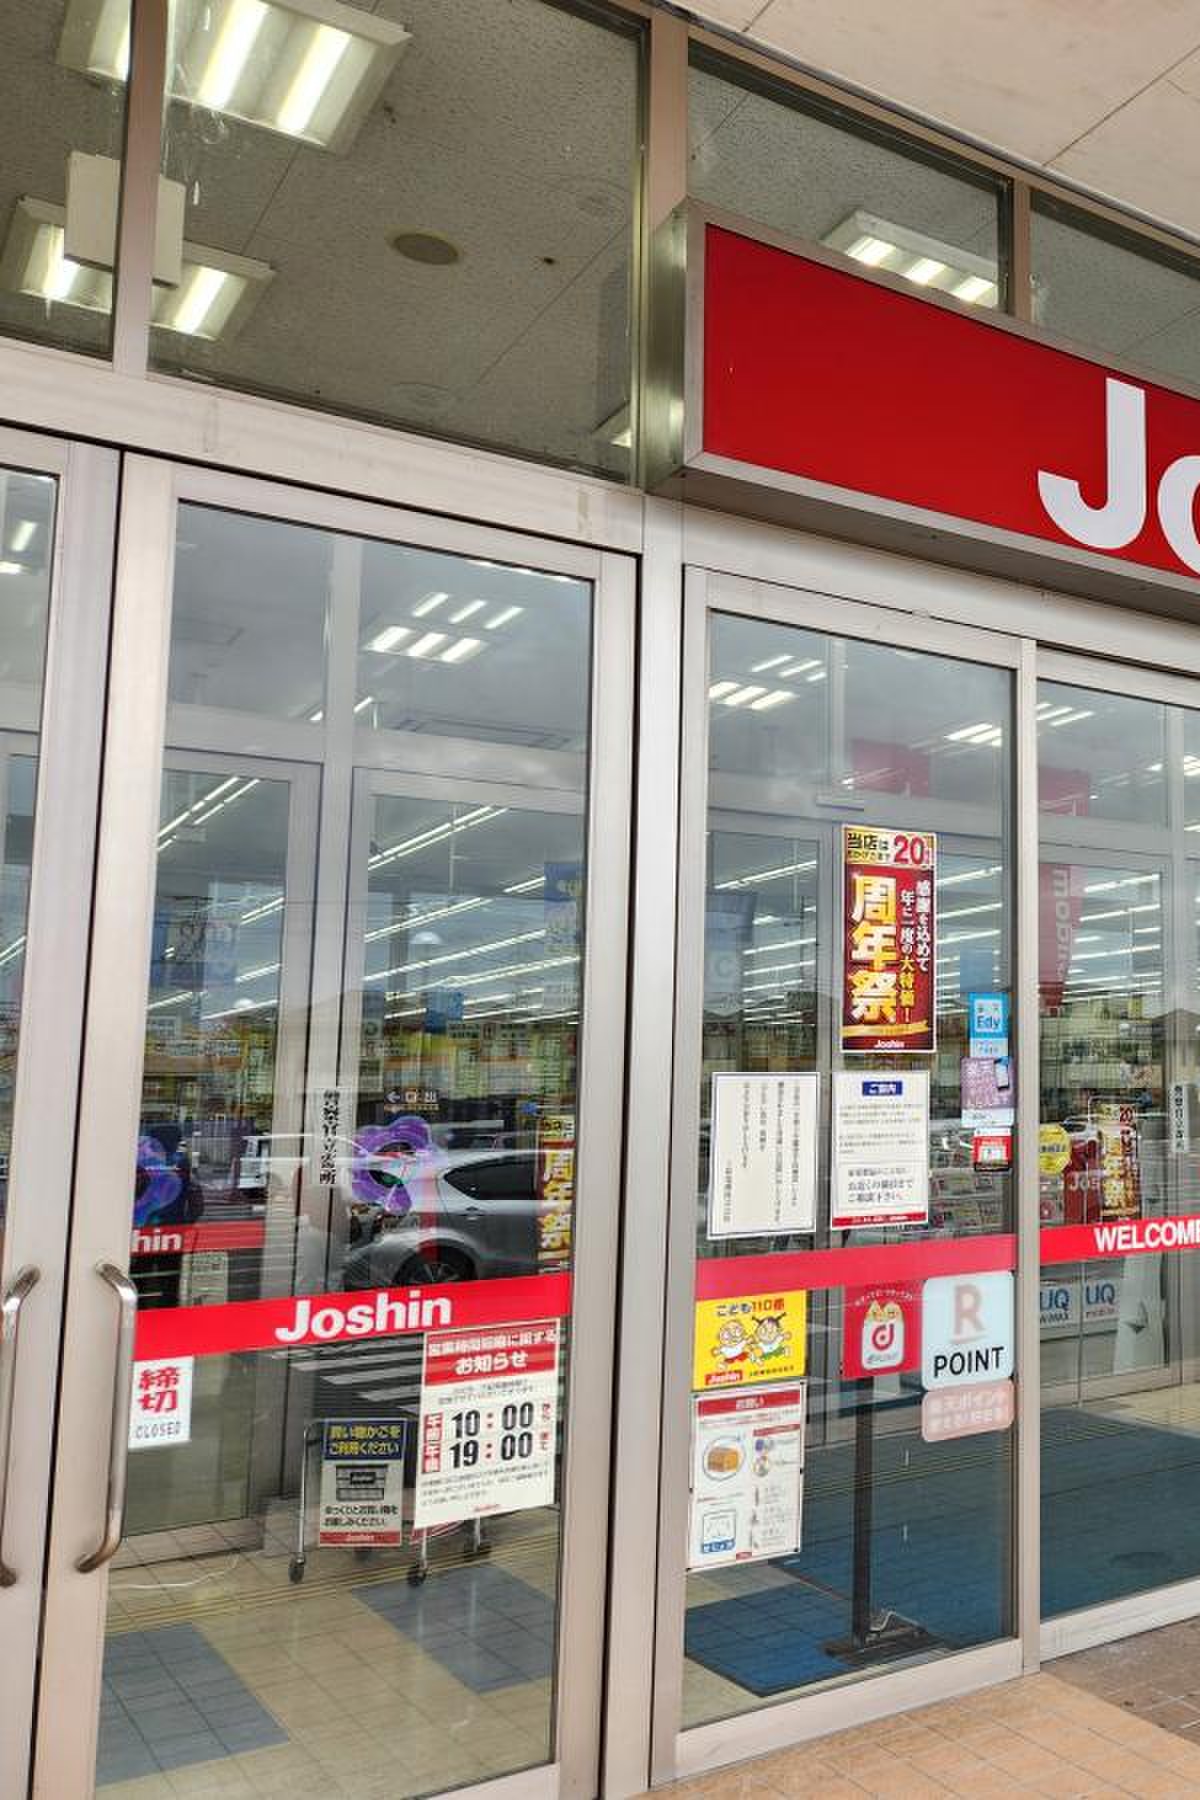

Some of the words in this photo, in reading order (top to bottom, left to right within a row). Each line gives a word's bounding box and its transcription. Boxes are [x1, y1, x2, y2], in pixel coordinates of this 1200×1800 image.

[895, 835, 924, 864] 20
[849, 875, 897, 1023] 周年祭
[954, 1284, 987, 1335] R
[1086, 1283, 1115, 1305] UQ
[275, 1292, 452, 1343] Joshin
[455, 1351, 528, 1375] お知らせ
[934, 1346, 1004, 1379] POINT
[139, 1366, 179, 1412] 締切
[136, 1422, 181, 1439] CLOSED
[451, 1402, 535, 1439] 10:00
[449, 1432, 534, 1469] 19:00
